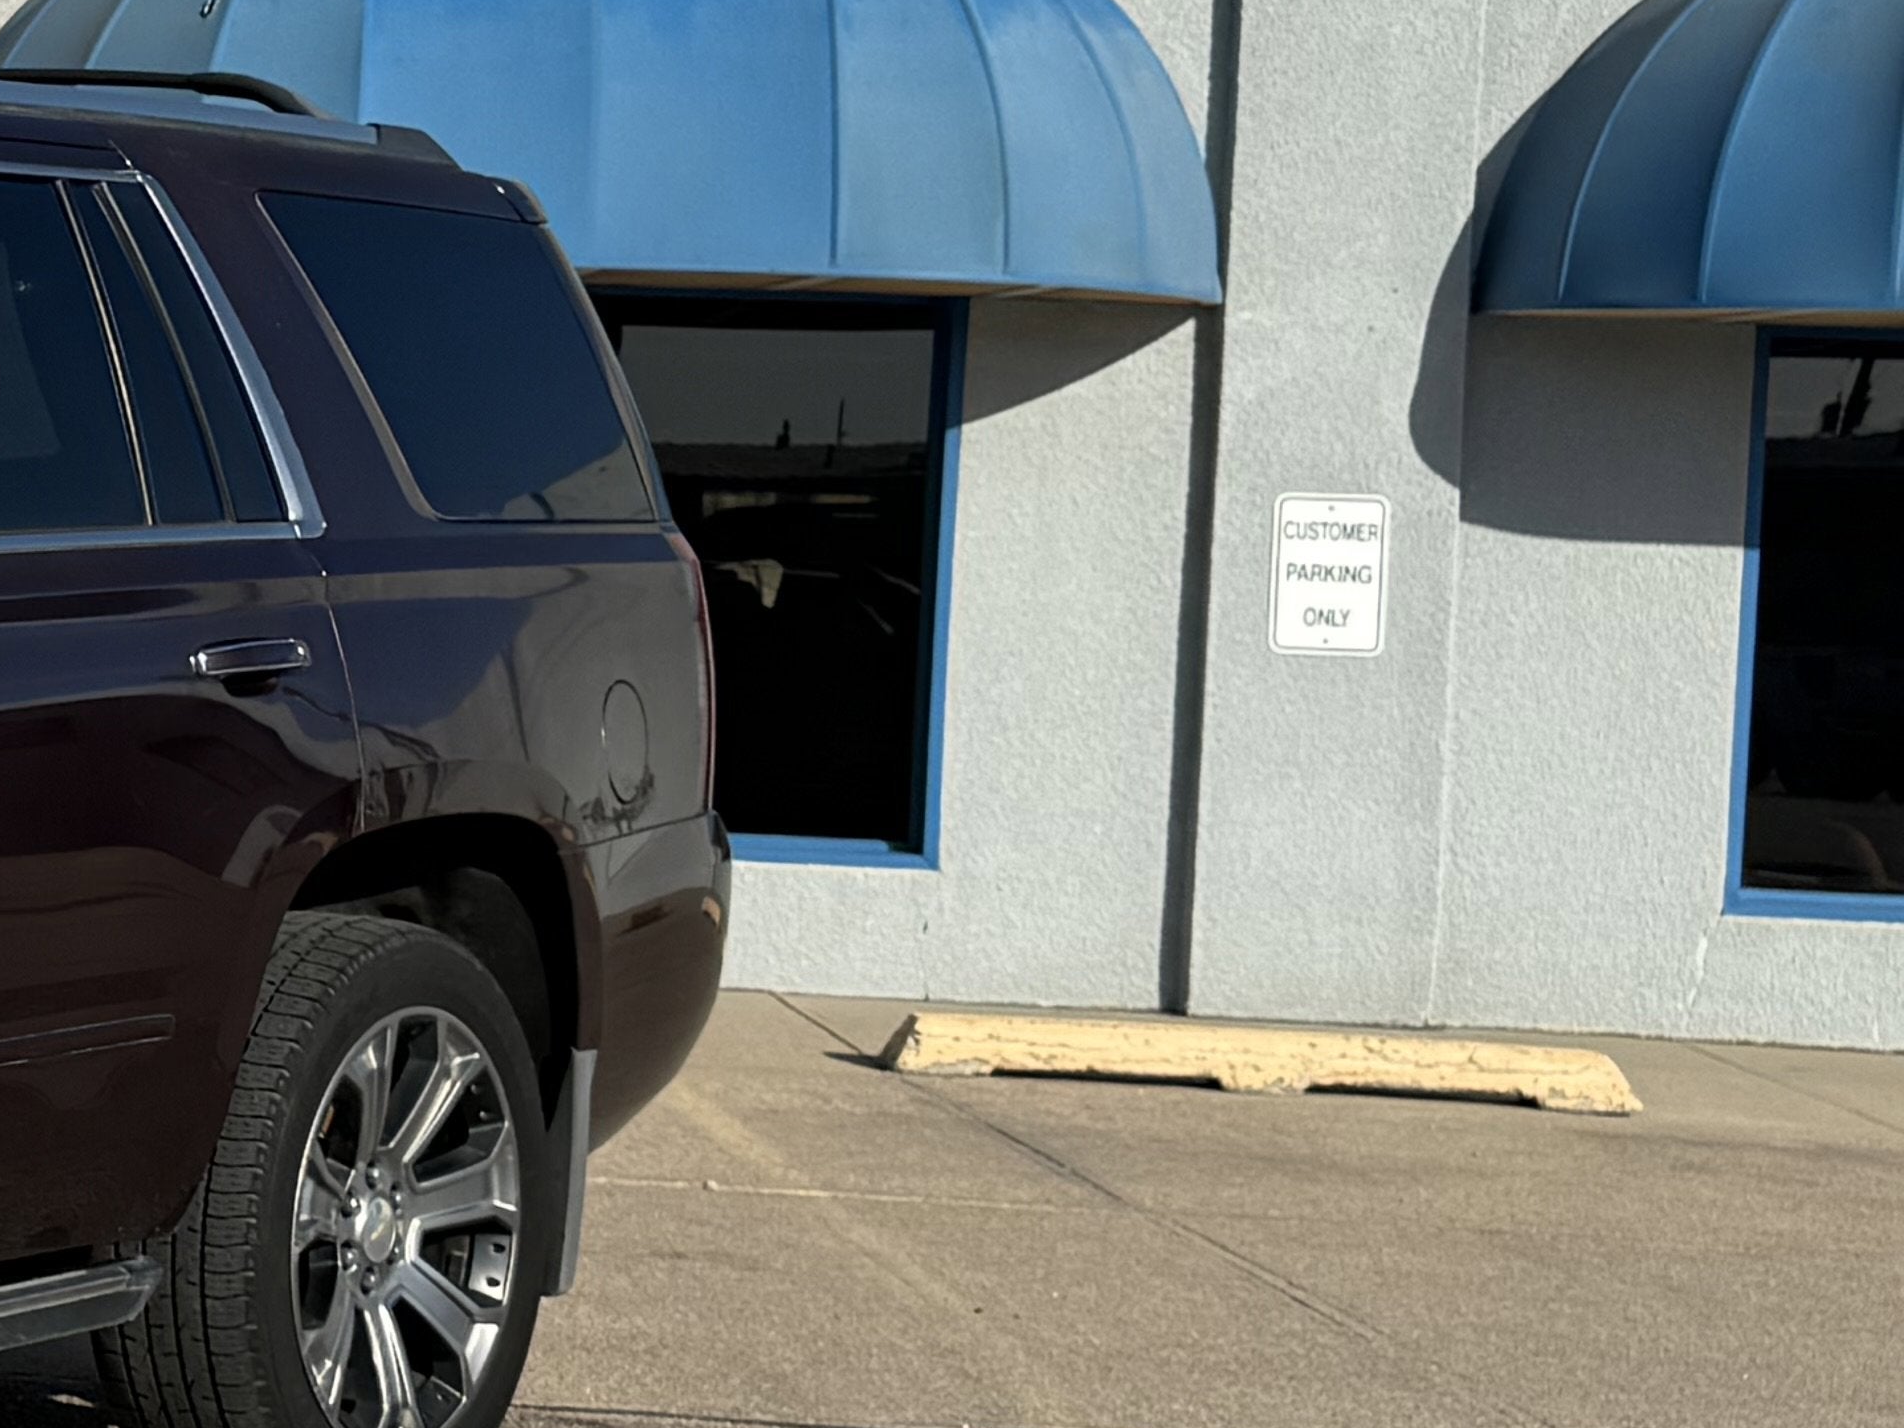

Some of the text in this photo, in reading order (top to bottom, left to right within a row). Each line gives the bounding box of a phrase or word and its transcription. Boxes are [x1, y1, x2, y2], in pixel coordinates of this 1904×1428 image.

[1282, 520, 1378, 542] CUSTOMER
[1285, 562, 1373, 584] PARKING
[1302, 606, 1351, 627] ONLY
